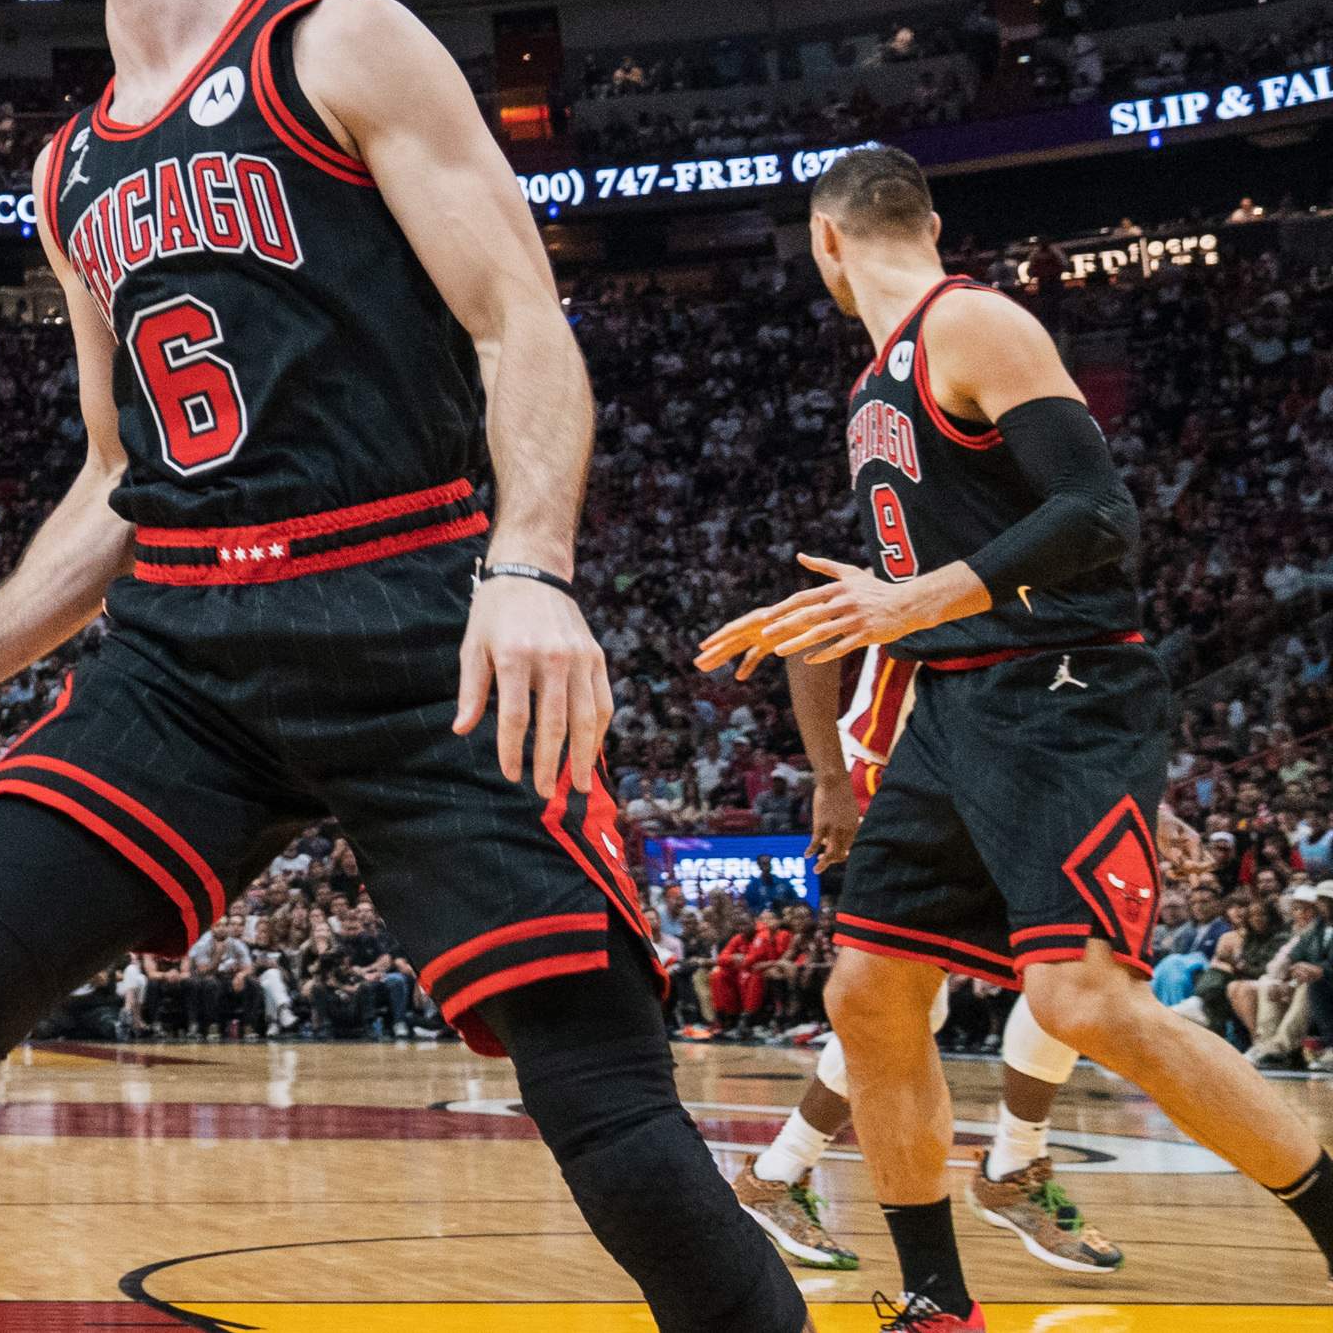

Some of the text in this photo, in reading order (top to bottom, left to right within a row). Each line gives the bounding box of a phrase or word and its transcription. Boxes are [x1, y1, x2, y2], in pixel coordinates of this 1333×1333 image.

[1110, 91, 1210, 136] SLIP
[1215, 85, 1256, 120] &
[595, 154, 783, 199] 747-FREE
[127, 293, 249, 477] 6
[870, 482, 919, 583] 9
